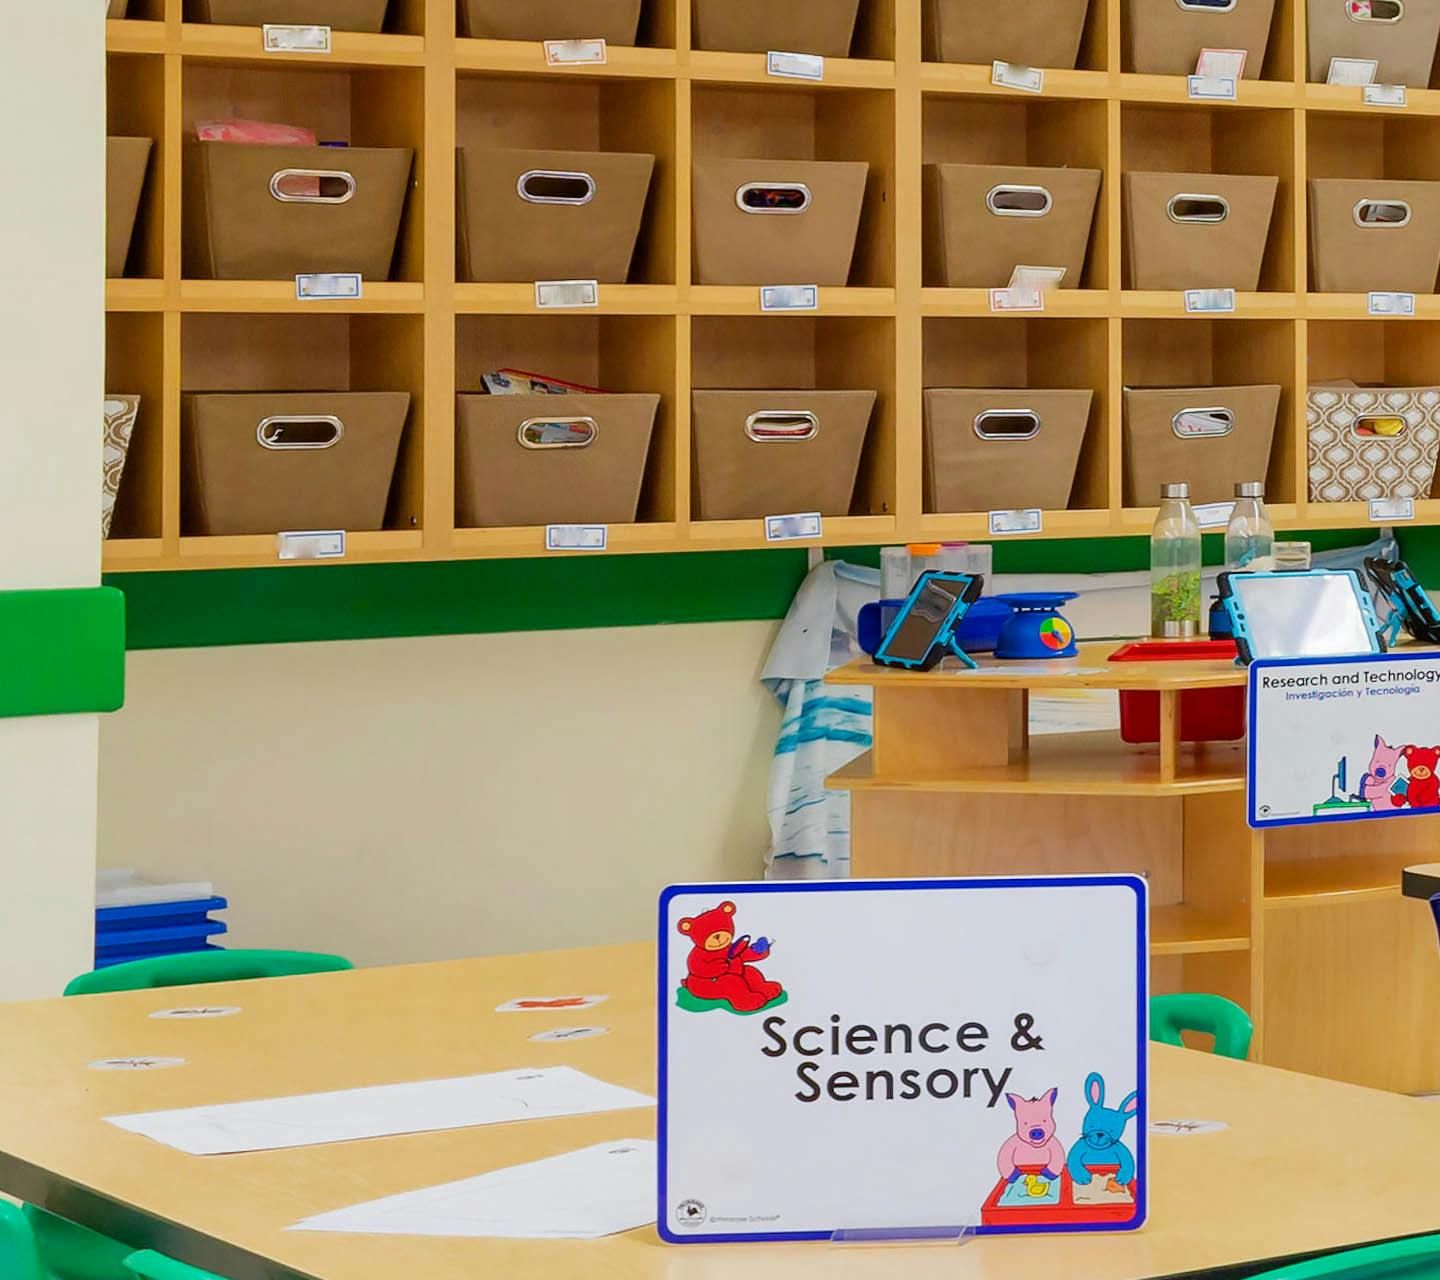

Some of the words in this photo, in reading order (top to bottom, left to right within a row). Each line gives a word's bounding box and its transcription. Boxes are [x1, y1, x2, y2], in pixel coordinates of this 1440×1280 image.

[1262, 673, 1327, 688] Research
[1332, 670, 1359, 685] and
[1285, 686, 1353, 701] Investigación
[1357, 689, 1362, 698] y
[760, 1014, 989, 1059] Science
[1011, 1012, 1045, 1051] &
[794, 1061, 1013, 1107] Sensory
